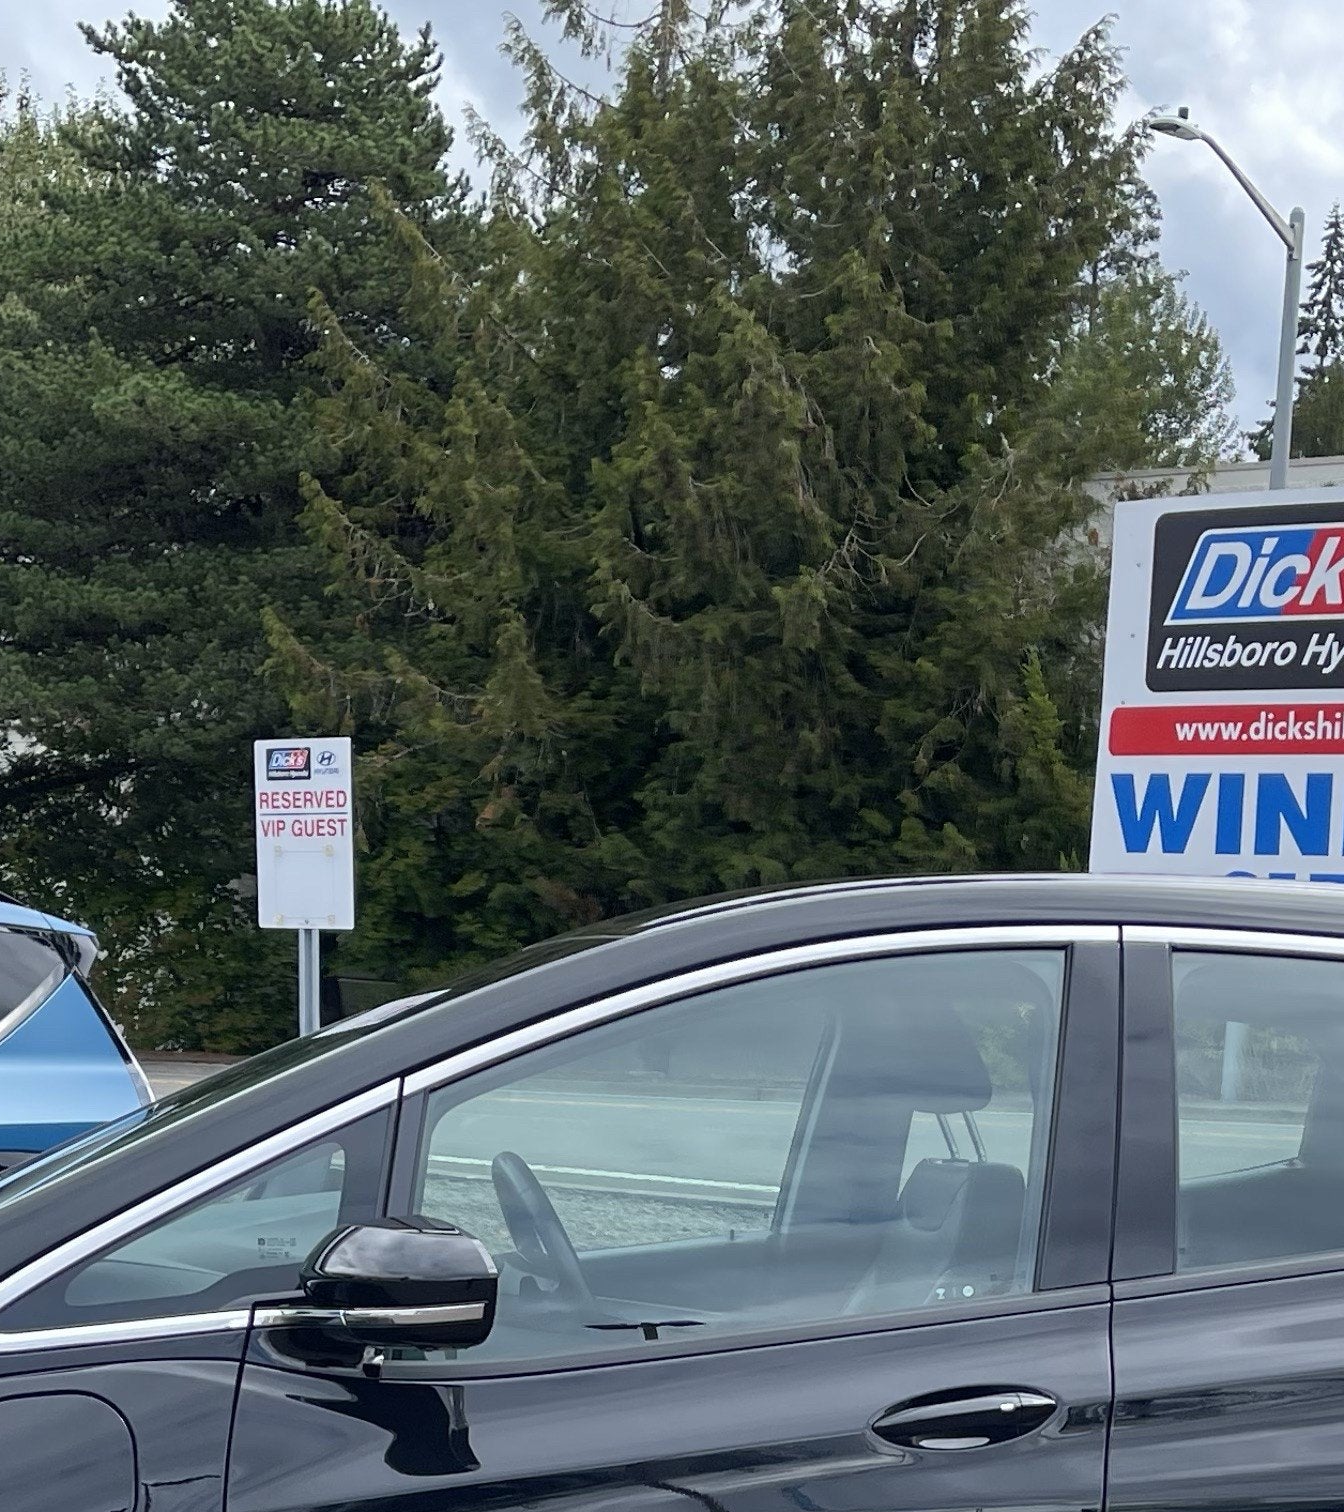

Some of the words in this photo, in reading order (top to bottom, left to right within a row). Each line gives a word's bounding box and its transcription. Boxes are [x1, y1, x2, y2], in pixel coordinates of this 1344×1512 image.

[1156, 635, 1298, 671] Hillsboro
[259, 790, 348, 810] RESERVED
[260, 819, 286, 838] VIP
[291, 818, 348, 838] GUEST
